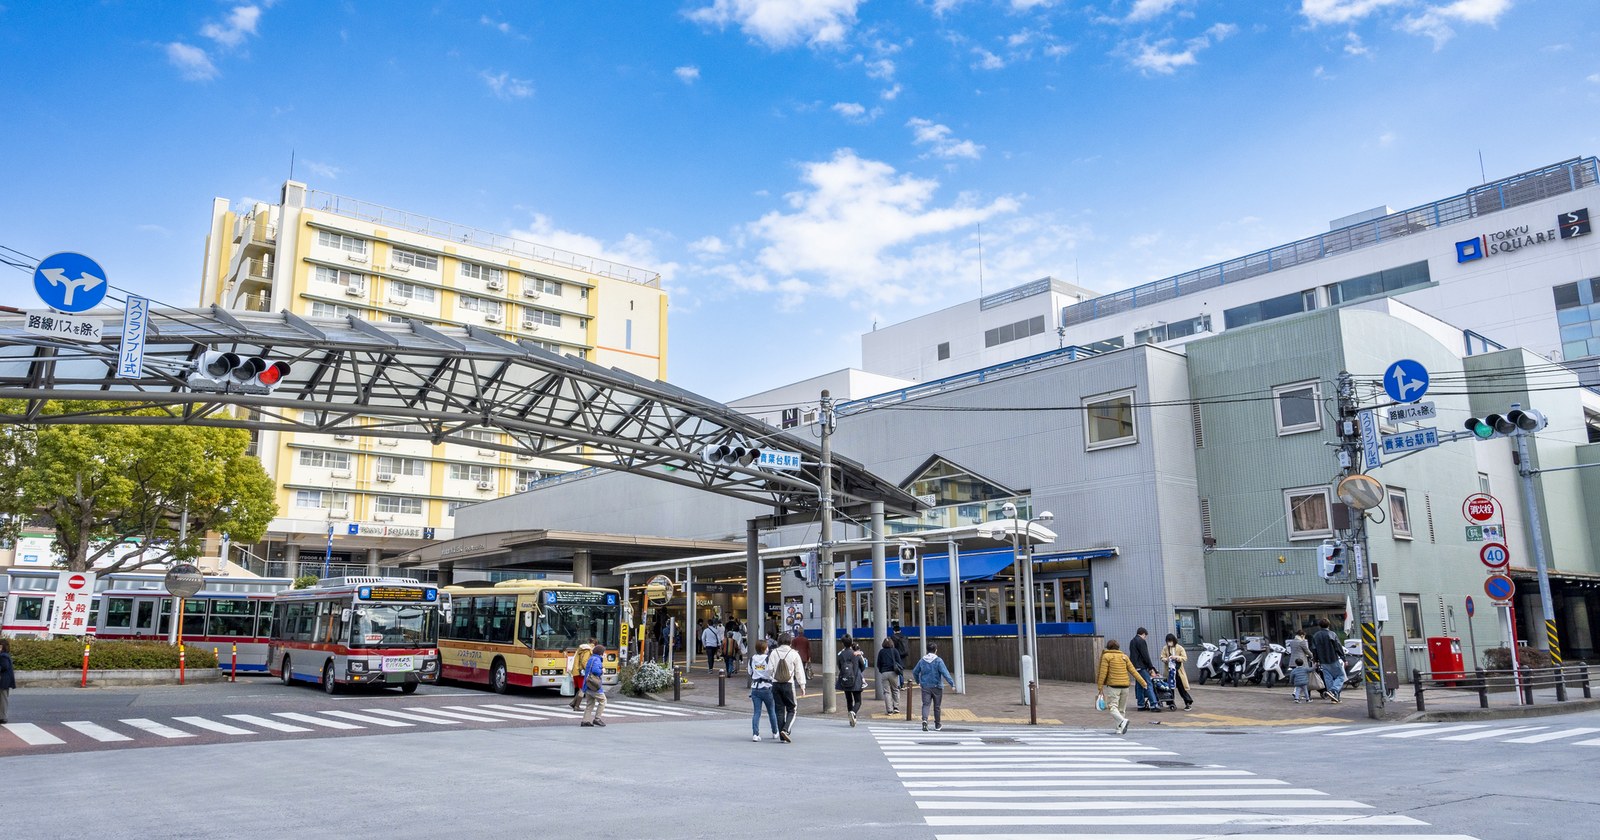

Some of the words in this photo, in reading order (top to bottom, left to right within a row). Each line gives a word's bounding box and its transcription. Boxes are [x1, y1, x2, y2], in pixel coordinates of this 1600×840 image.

[1568, 212, 1578, 223] S
[1490, 225, 1529, 241] TOKYU
[1570, 226, 1581, 237] 2
[1490, 229, 1556, 254] SQUARE
[630, 300, 634, 311] 1
[28, 314, 100, 338] 路線バスを除く
[786, 408, 793, 420] N
[1390, 405, 1434, 421] 路線バスを除く
[1384, 432, 1436, 450] 青葉台駅前
[760, 452, 799, 467] 青葉台駅前
[1470, 504, 1492, 514] 消火栓
[388, 528, 420, 536] SQUARE
[1486, 549, 1504, 562] 40
[60, 592, 76, 630] 進入禁止
[72, 592, 88, 626] 一般車
